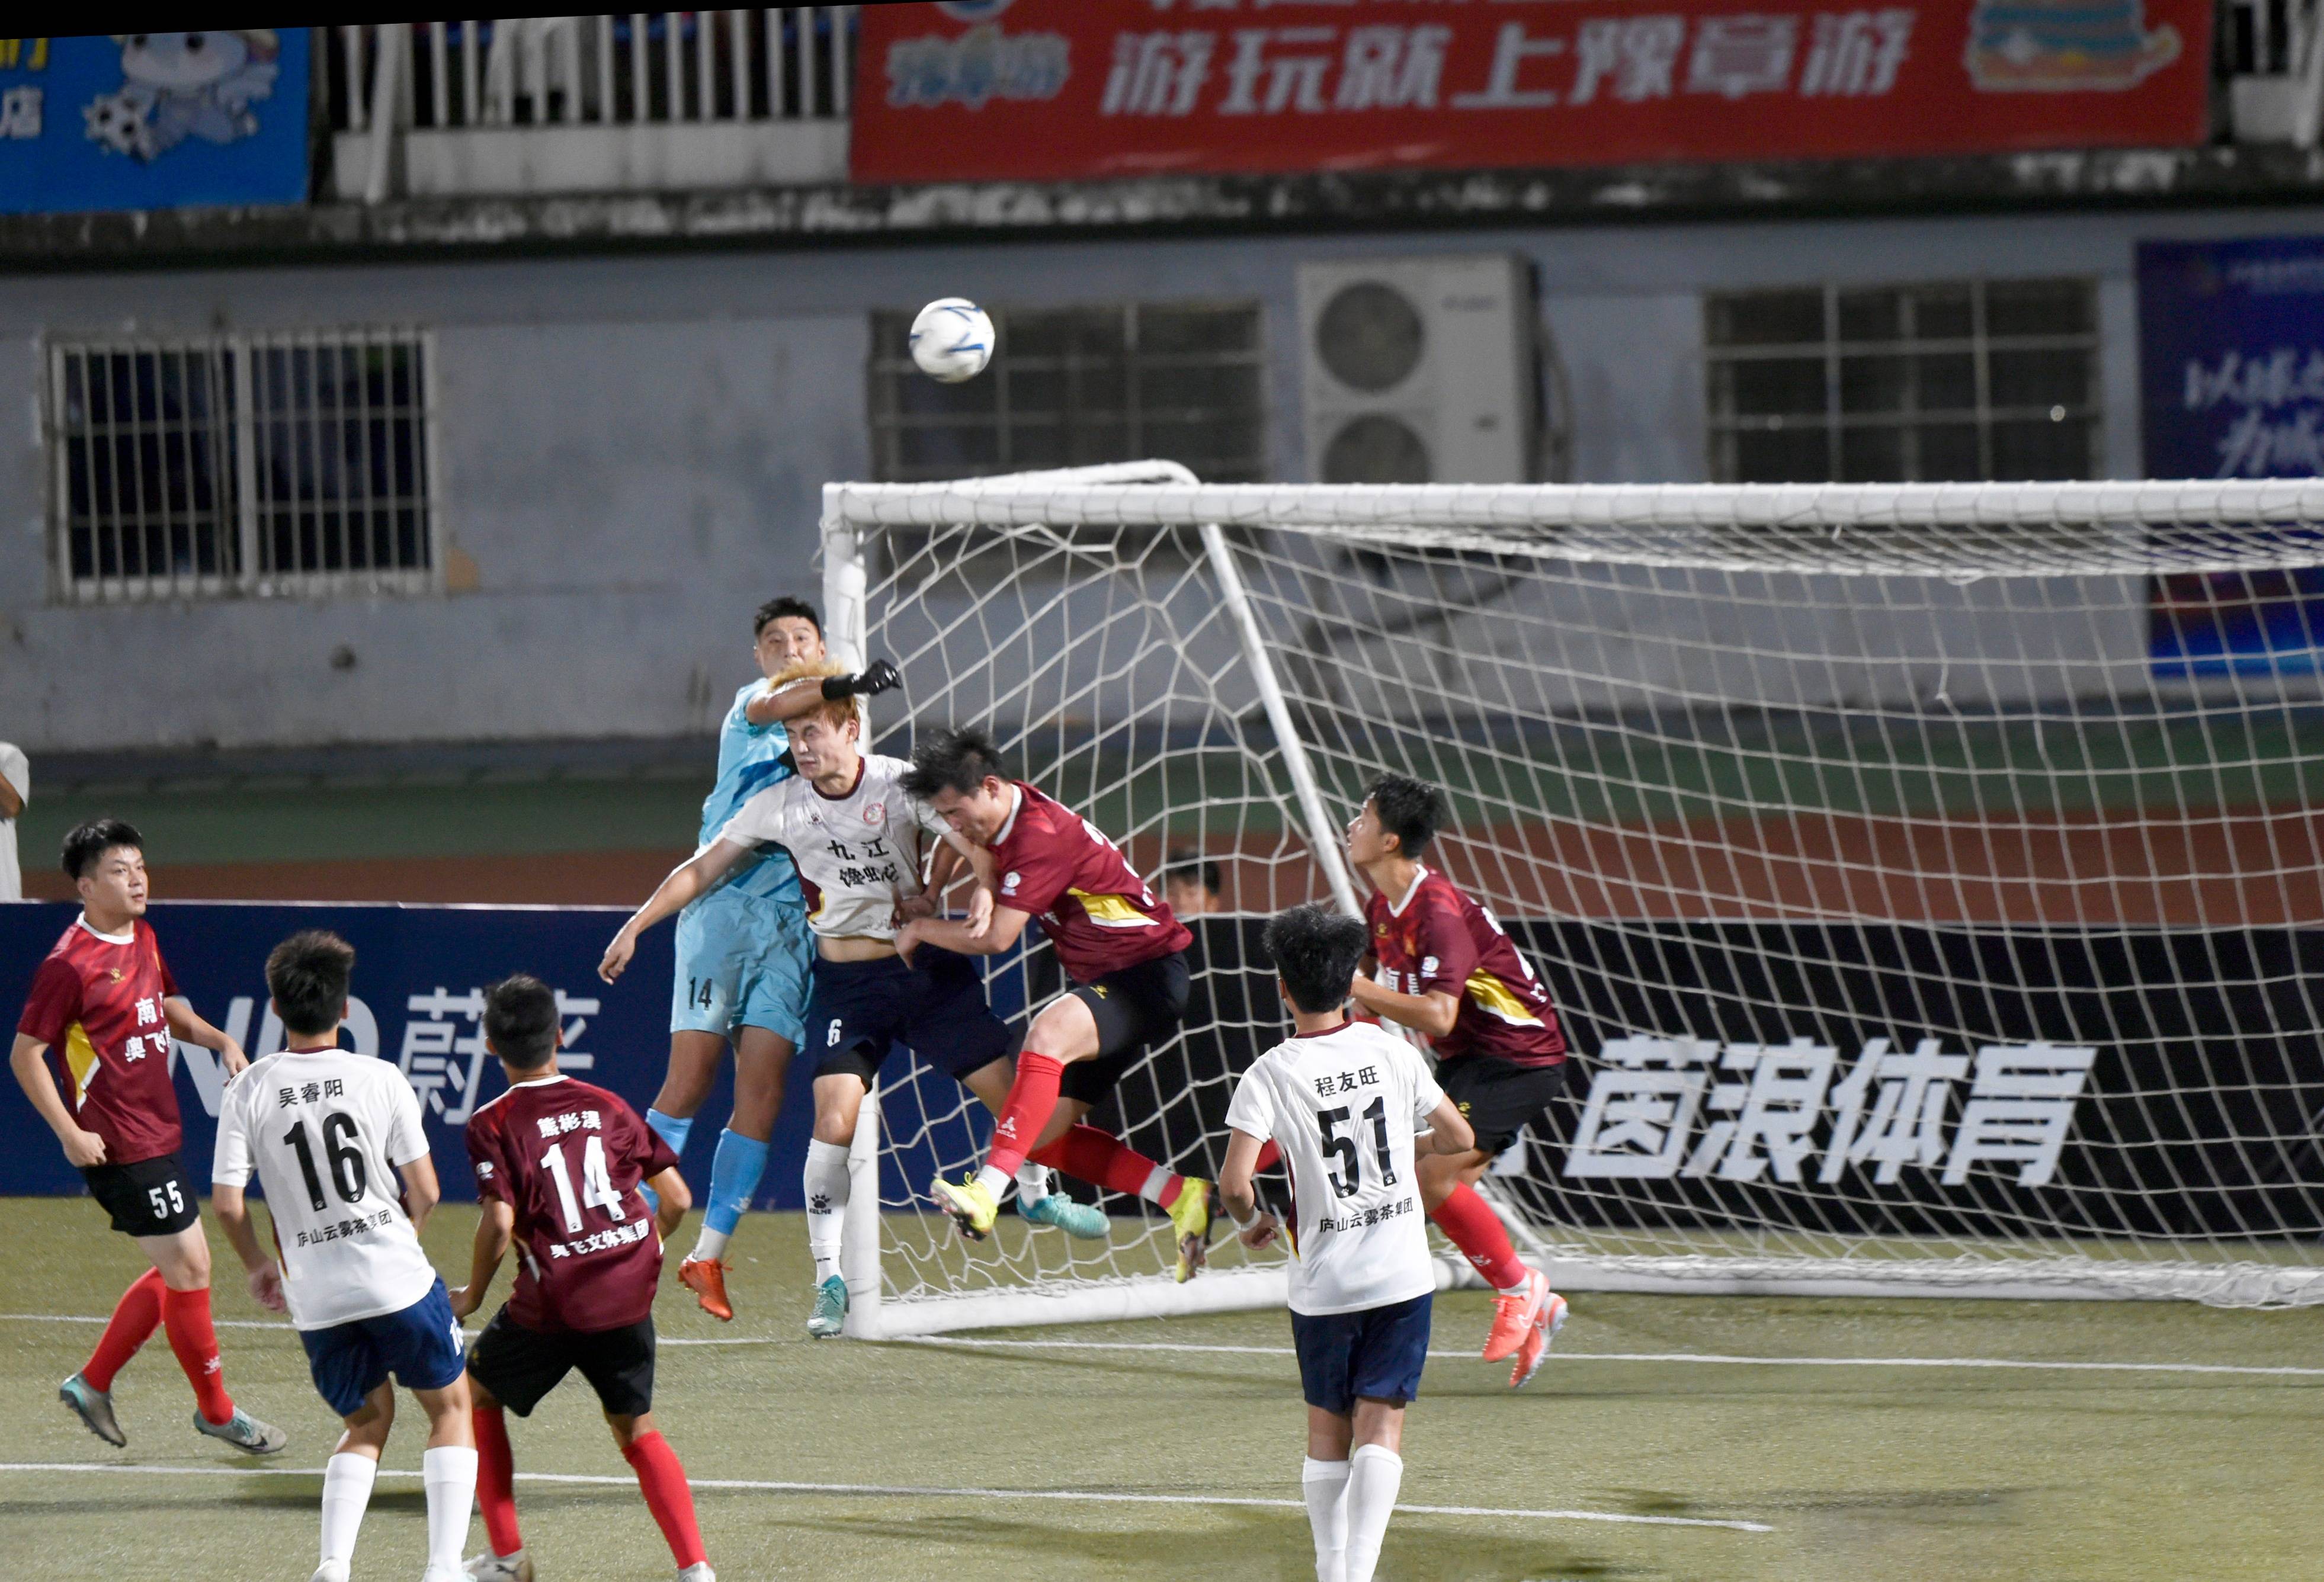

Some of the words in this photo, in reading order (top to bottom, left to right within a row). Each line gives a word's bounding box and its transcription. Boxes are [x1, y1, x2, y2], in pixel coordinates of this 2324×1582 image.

[1100, 8, 1916, 115] 游玩就上豫章游
[826, 837, 889, 861] 九江
[689, 977, 712, 1011] 14
[826, 1018, 842, 1047] 6
[279, 1079, 344, 1108] 吴睿阳
[1314, 1065, 1380, 1098] 程友旺
[1563, 1034, 2098, 1187] 茵浪体育
[283, 1112, 366, 1212] 16
[1317, 1096, 1397, 1198] 51
[148, 1180, 184, 1219] 55
[540, 1135, 626, 1233] 14
[1319, 1197, 1413, 1233] 庐山云雾茶集团
